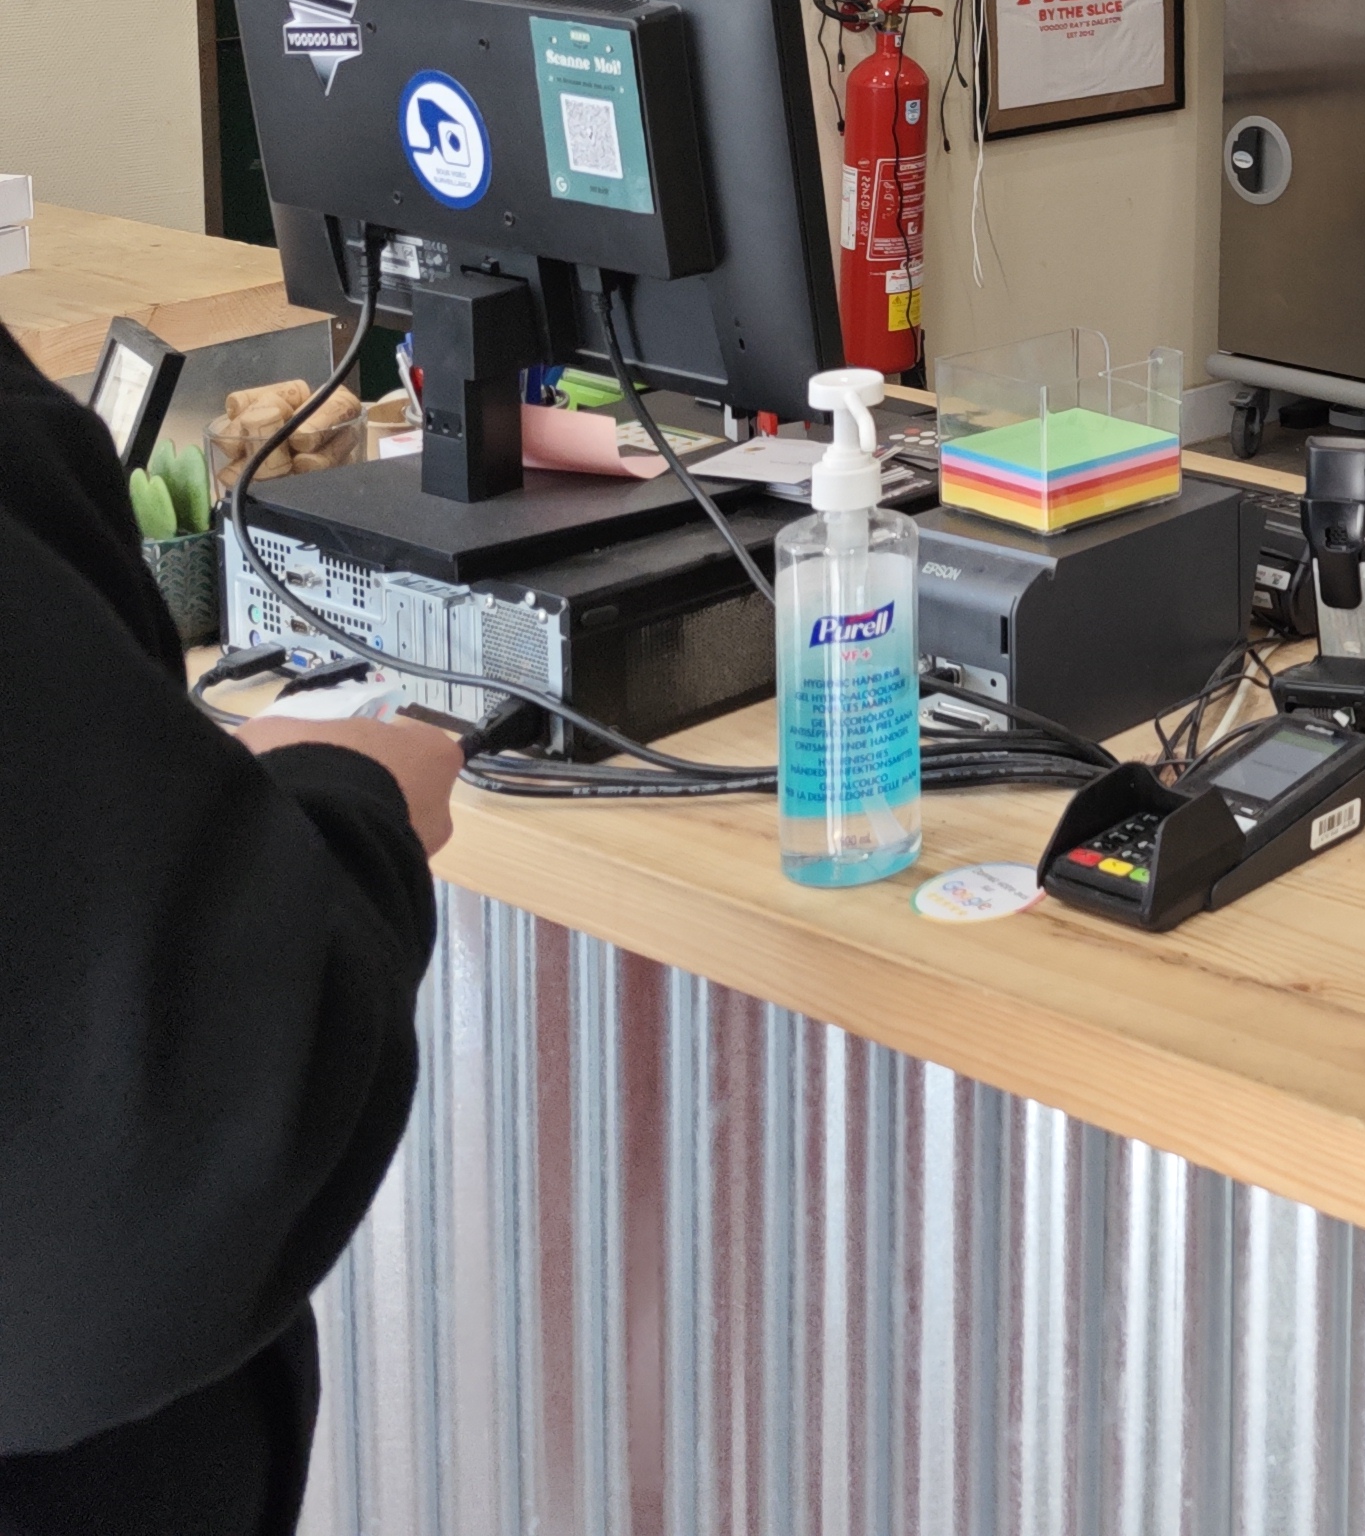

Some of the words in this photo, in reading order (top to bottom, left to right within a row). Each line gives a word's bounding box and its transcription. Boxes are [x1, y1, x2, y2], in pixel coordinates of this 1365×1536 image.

[1038, 9, 1054, 21] BY
[1057, 6, 1083, 19] THE
[1086, 0, 1123, 15] SLICE
[287, 32, 328, 46] VOODOO
[330, 32, 358, 46] RAY'S
[545, 49, 591, 71] Scanne
[594, 55, 622, 76] Moi!
[921, 561, 962, 581] EPSON
[818, 609, 889, 642] Purell
[852, 673, 882, 686] HAND
[884, 667, 900, 679] RUB
[862, 695, 893, 709] MAINS
[848, 724, 873, 737] PARA
[878, 779, 900, 795] DELLE
